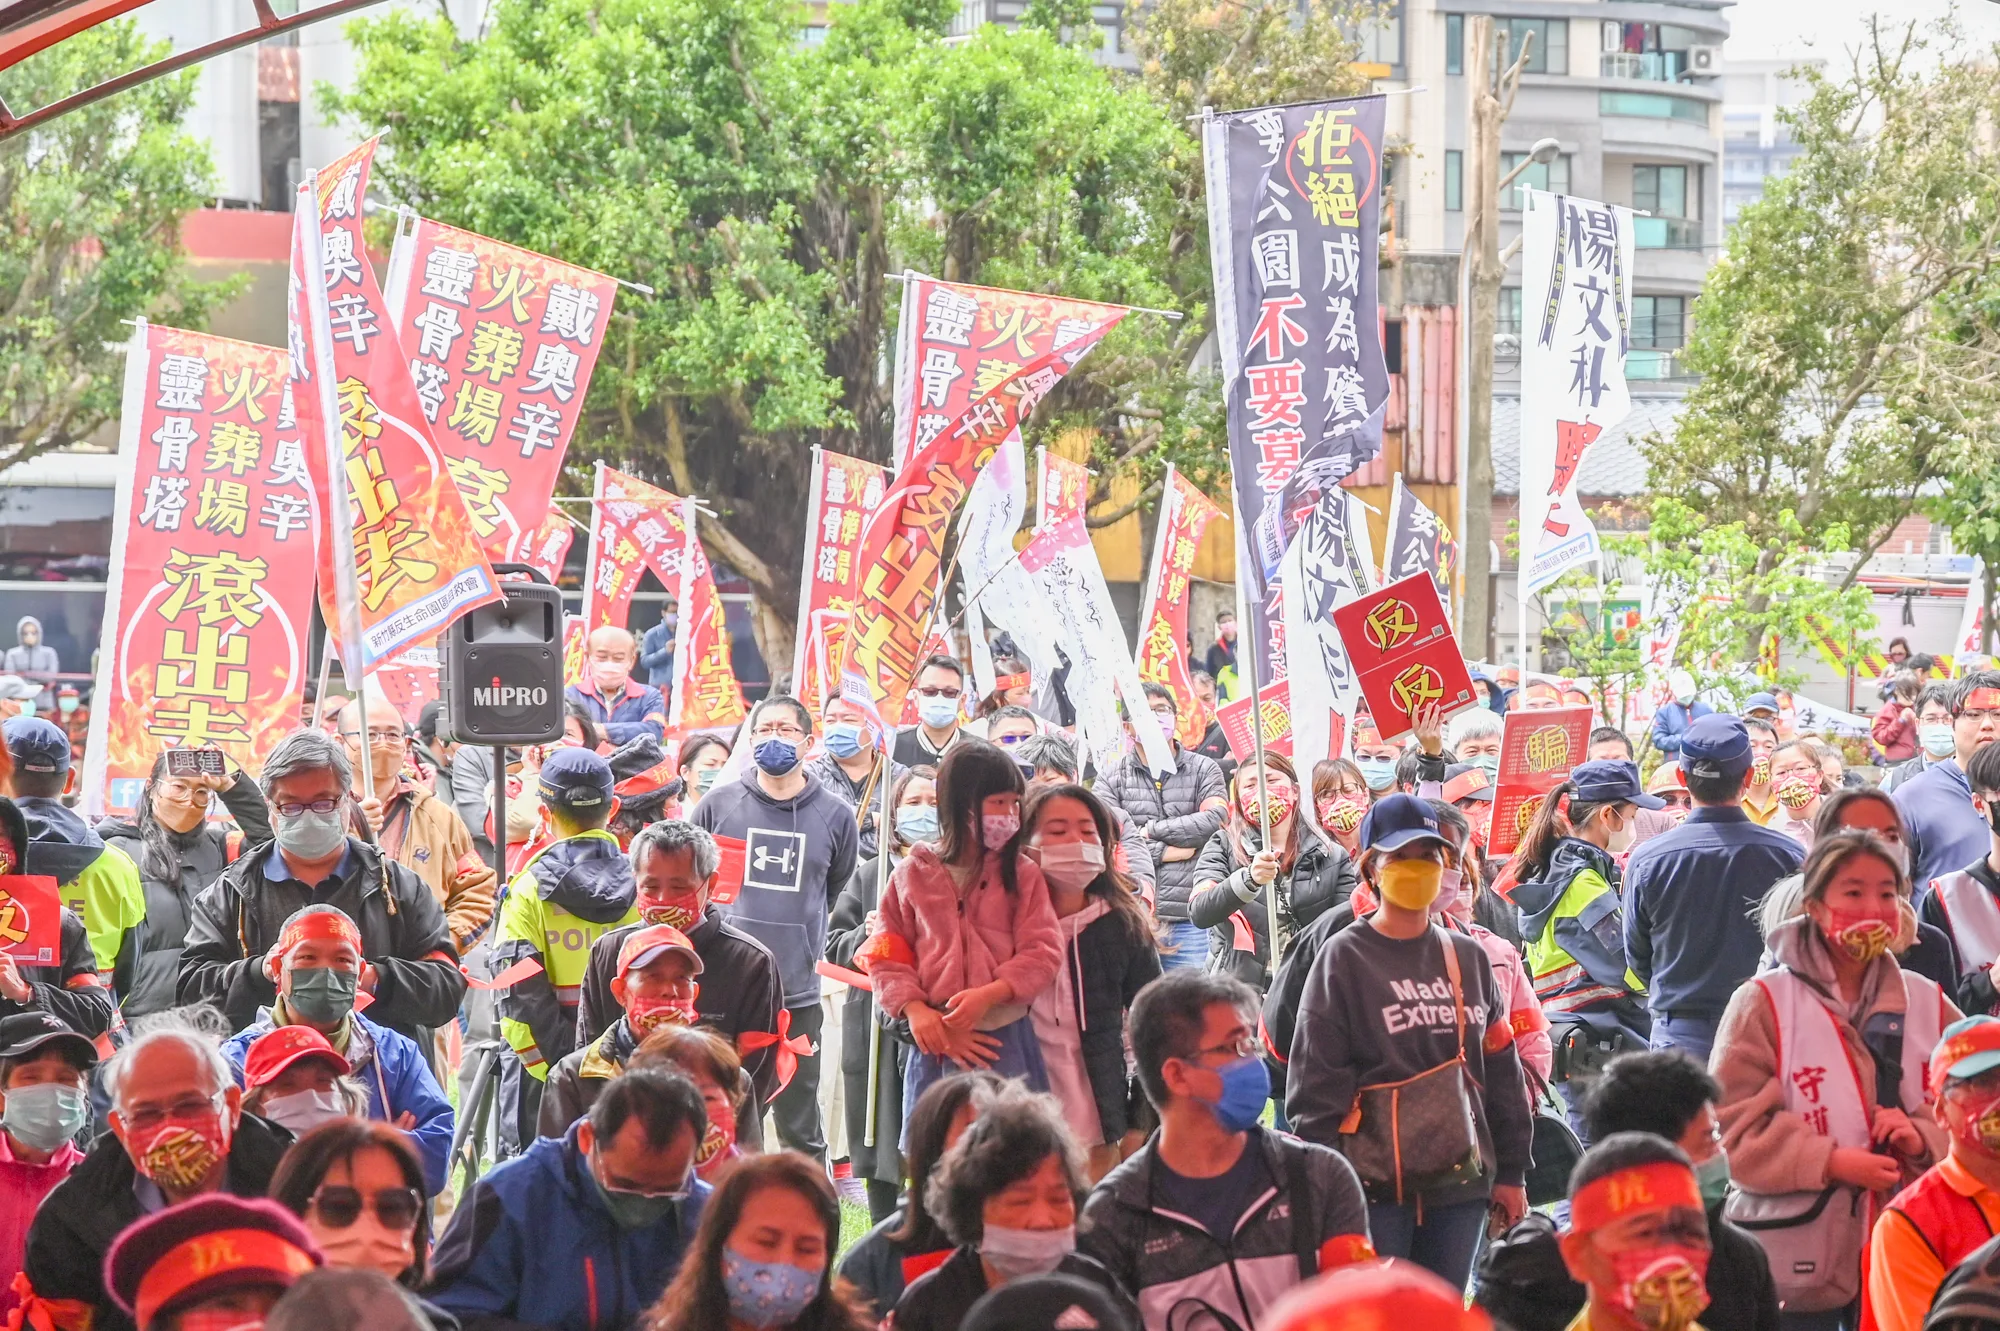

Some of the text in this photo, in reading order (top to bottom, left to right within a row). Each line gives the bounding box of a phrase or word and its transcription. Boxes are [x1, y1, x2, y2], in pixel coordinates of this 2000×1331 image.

[322, 160, 381, 356] 戴奧辛
[1566, 203, 1614, 409] 楊文科
[410, 246, 479, 424] 靈骨塔
[447, 265, 537, 447] 火葬場
[508, 283, 599, 459] 戴奧辛
[914, 285, 980, 455] 靈骨塔
[139, 353, 210, 531] 靈骨塔
[193, 366, 270, 537] 火葬場
[816, 465, 847, 584] 靈骨塔
[148, 547, 270, 778] 滾出去
[1366, 597, 1419, 654] 反
[1391, 662, 1445, 719] 反
[172, 751, 223, 774] 興建
[653, 766, 673, 785] 抗
[1467, 772, 1486, 788] 抗
[1528, 724, 1567, 774] 騙
[286, 925, 304, 949] 抗
[1608, 1170, 1655, 1214] 抗
